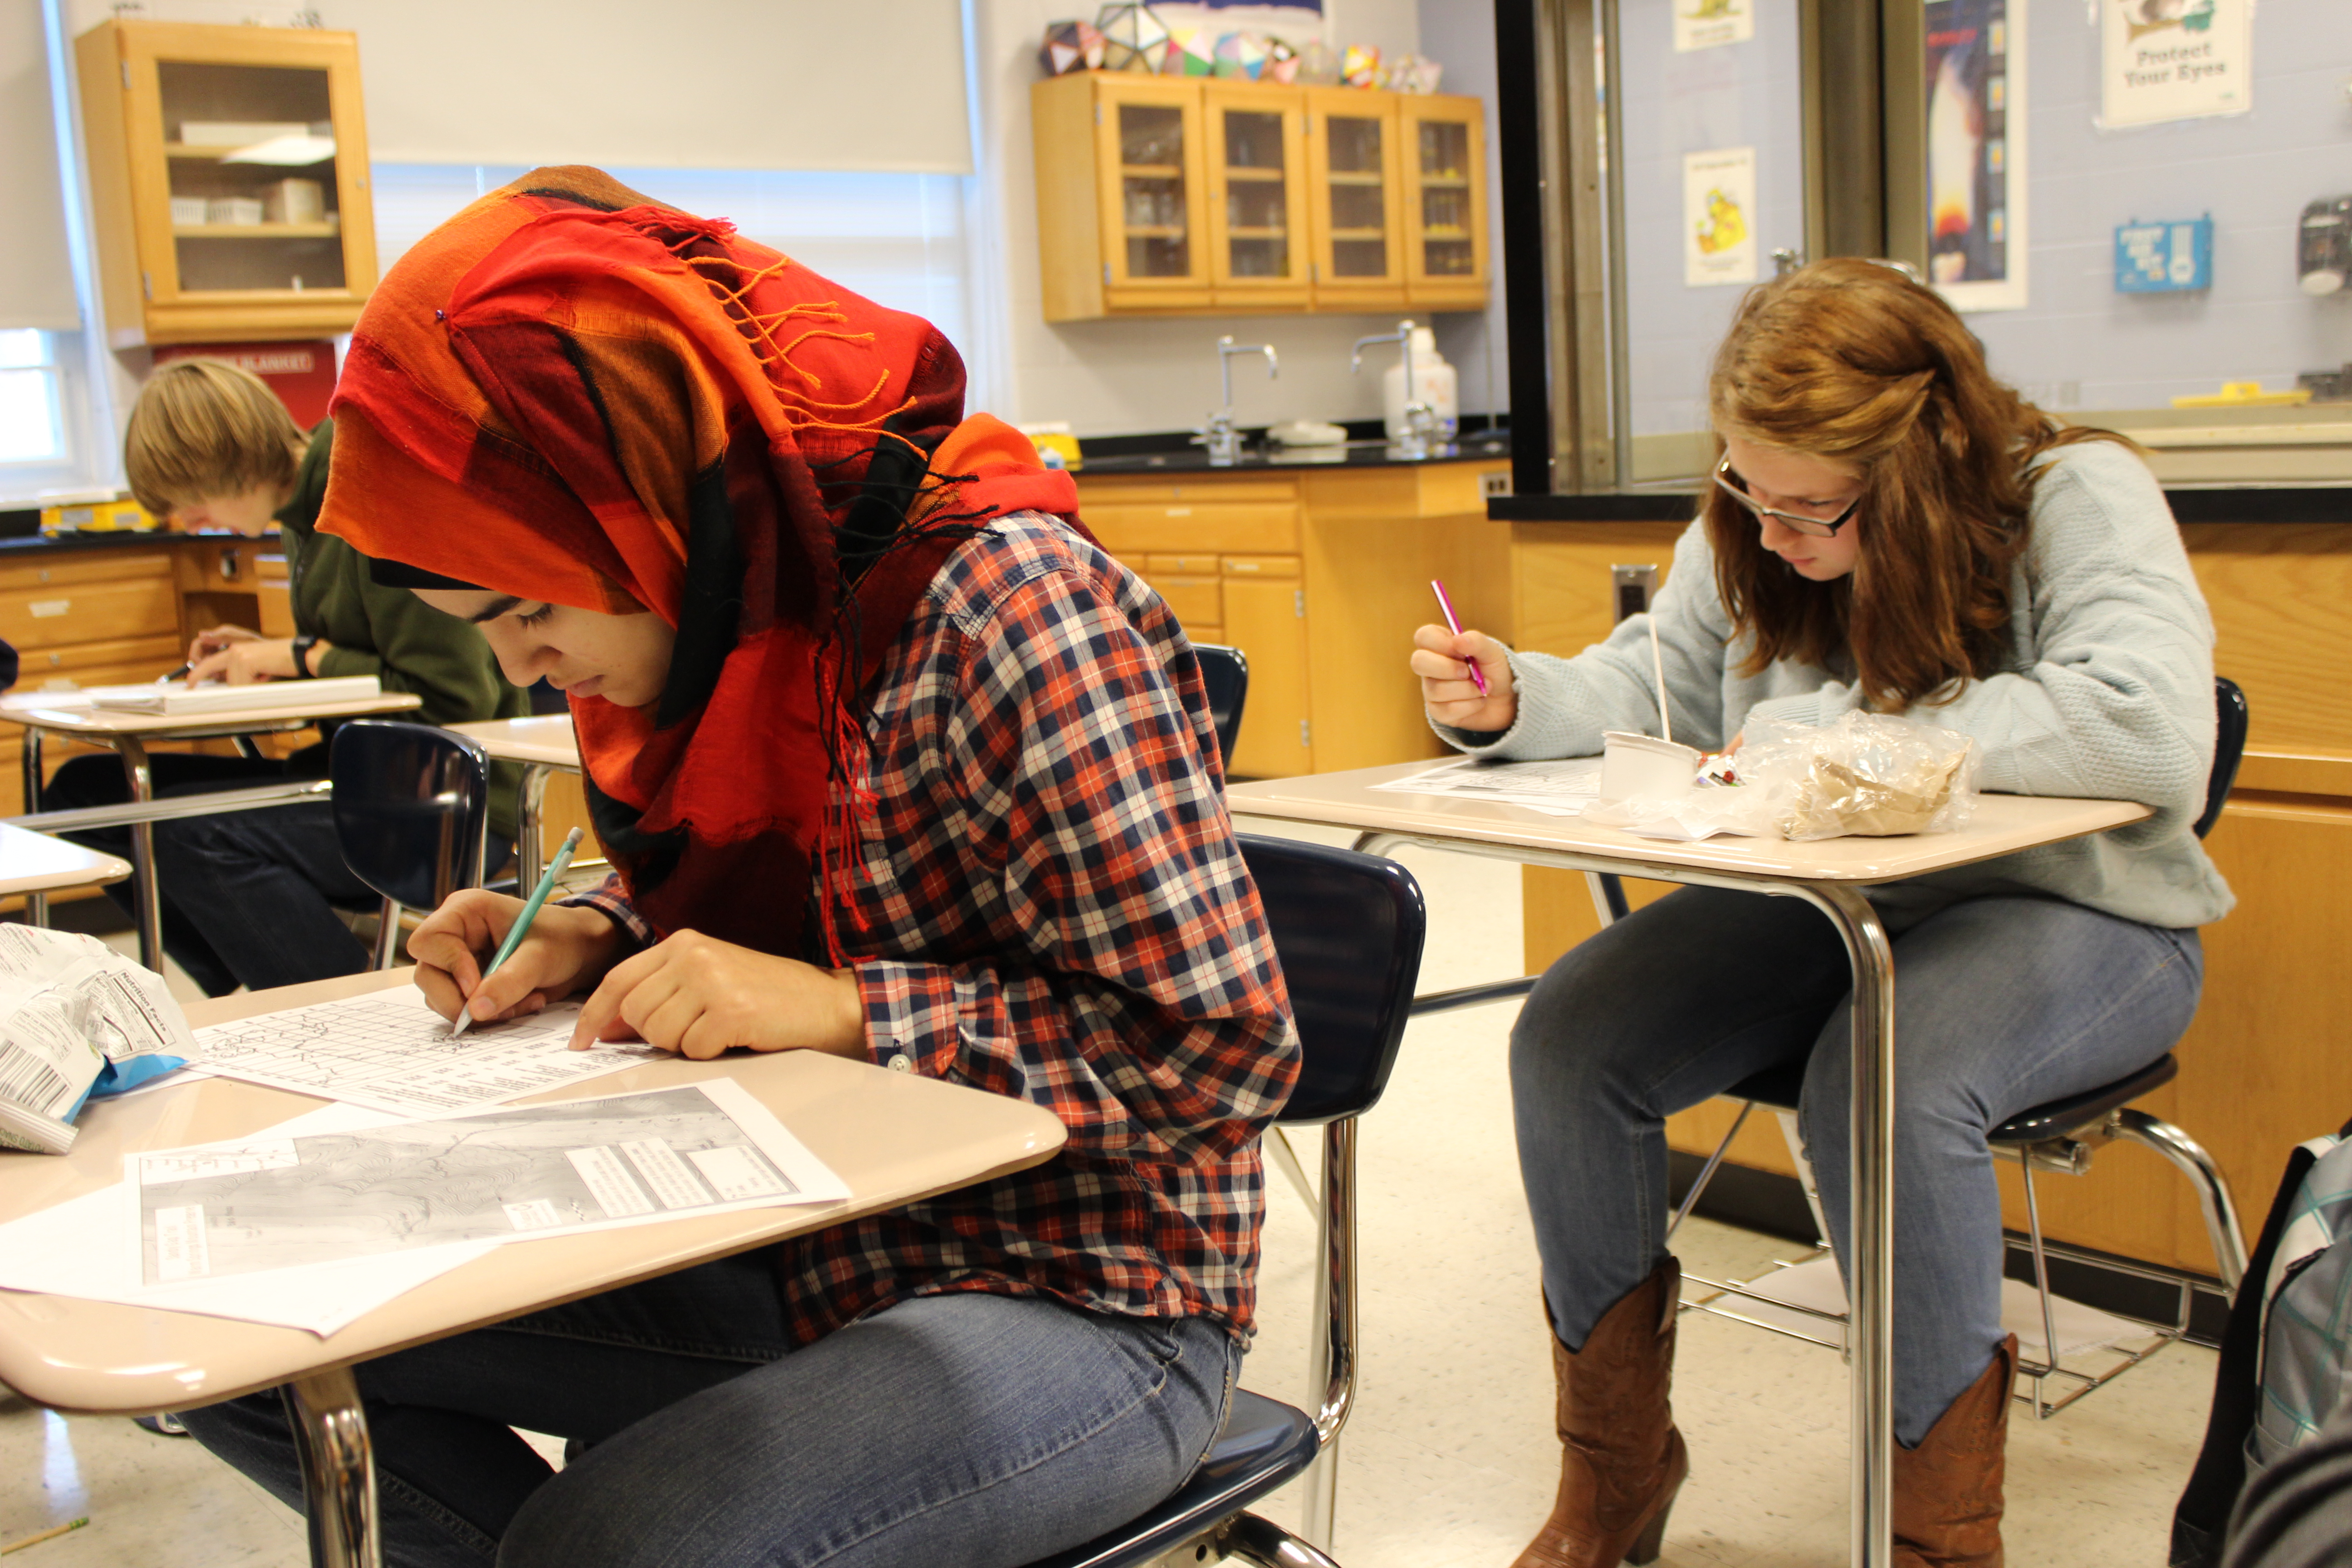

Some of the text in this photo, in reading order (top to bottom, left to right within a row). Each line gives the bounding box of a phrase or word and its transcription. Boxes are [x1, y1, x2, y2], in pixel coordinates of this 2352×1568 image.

[2136, 42, 2212, 67] Protect
[2124, 63, 2226, 88] Your Eyes
[121, 972, 167, 1031] Nutrition Facts
